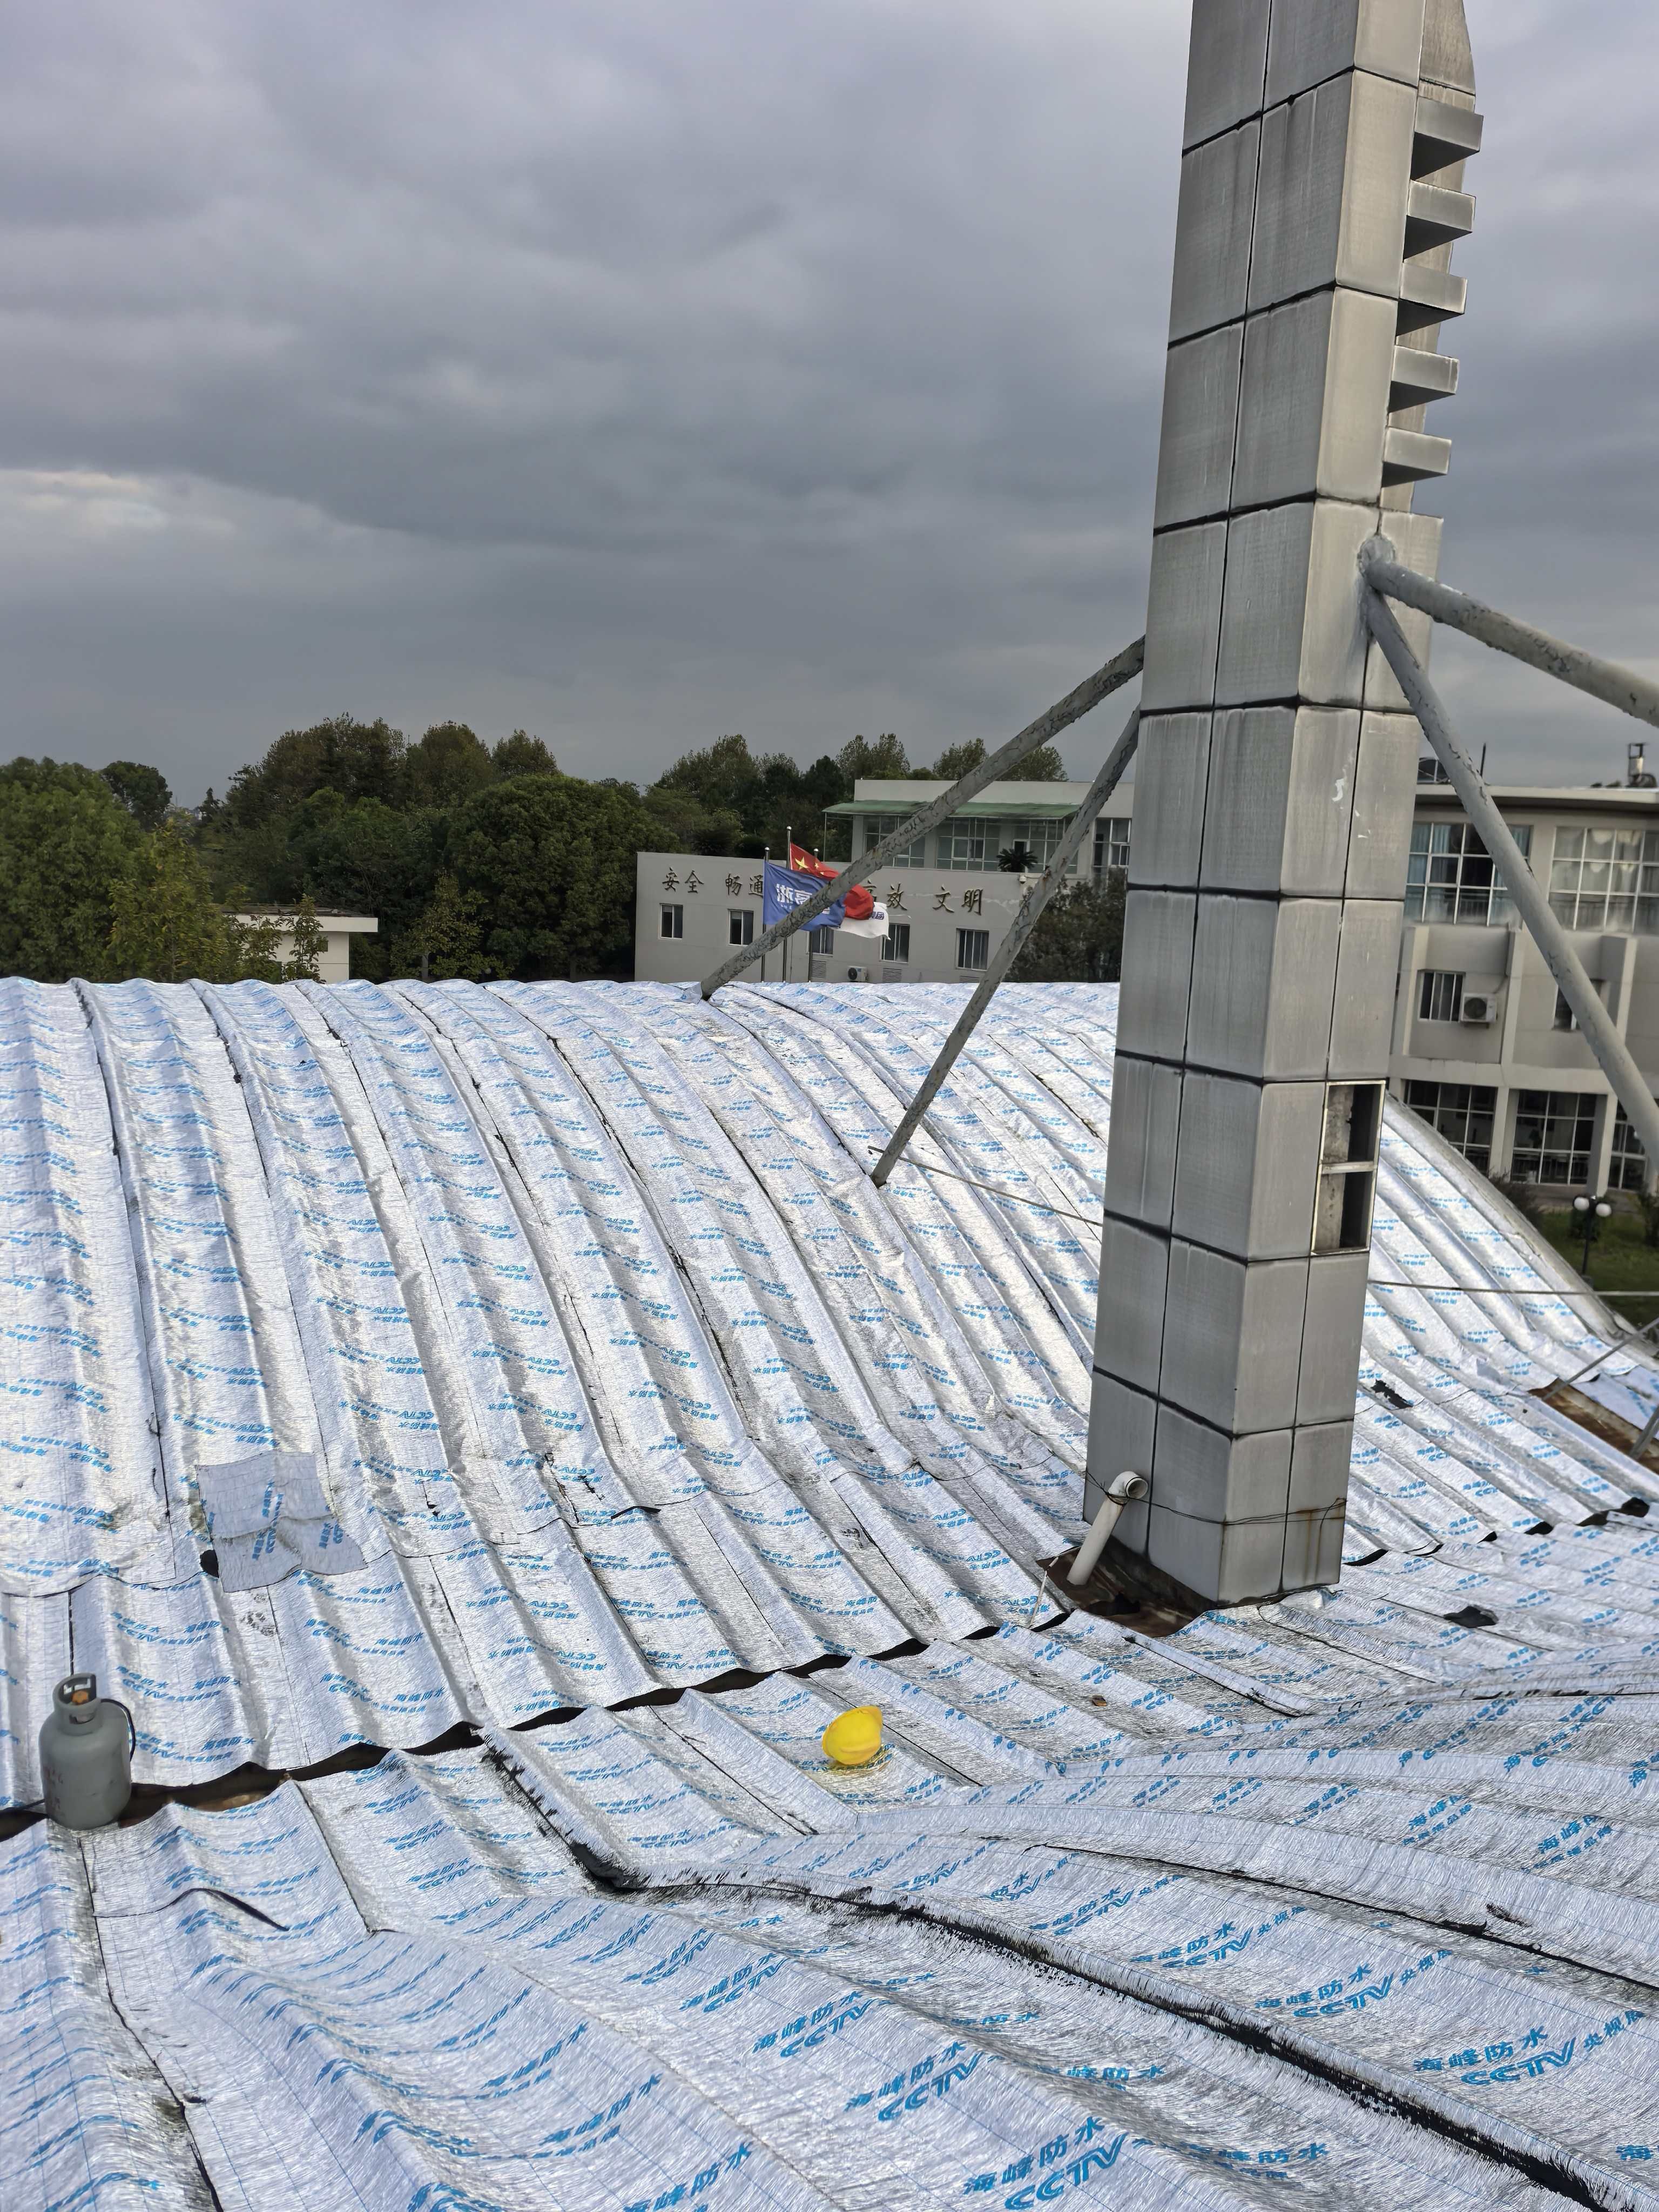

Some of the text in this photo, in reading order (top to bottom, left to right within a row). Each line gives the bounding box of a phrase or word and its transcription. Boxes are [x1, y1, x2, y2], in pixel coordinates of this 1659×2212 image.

[662, 867, 704, 893] 安全
[725, 873, 764, 899] 畅通
[933, 884, 983, 915] 文明
[1255, 1963, 1372, 2008] 海峰防水
[1293, 1972, 1394, 2018] CCTV
[780, 1998, 878, 2057] CCTV
[1414, 2026, 1548, 2071] 海峰防水
[1067, 2065, 1166, 2079] 峰防水
[1461, 2037, 1576, 2085] CCTV
[878, 2052, 984, 2121] CCTV
[963, 2116, 1104, 2195] 海峰防水
[1004, 2132, 1129, 2210] CCTV
